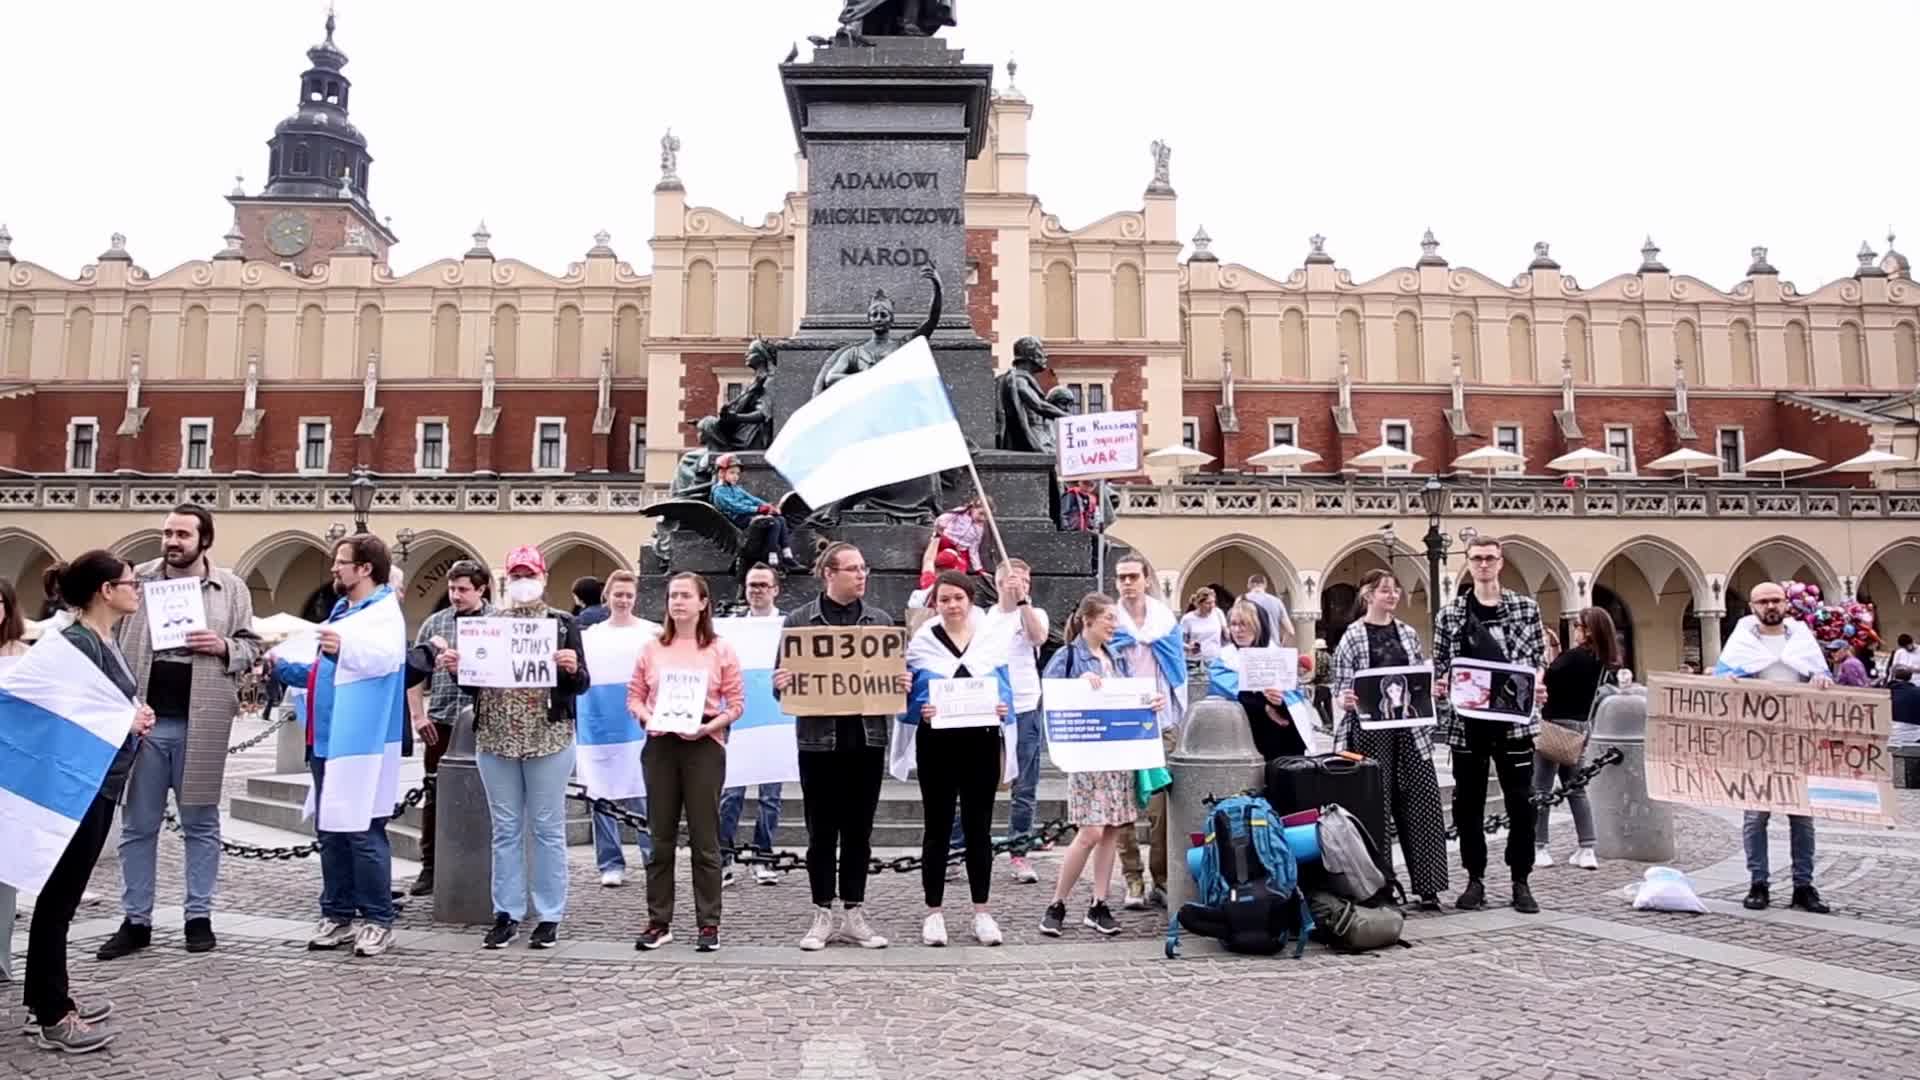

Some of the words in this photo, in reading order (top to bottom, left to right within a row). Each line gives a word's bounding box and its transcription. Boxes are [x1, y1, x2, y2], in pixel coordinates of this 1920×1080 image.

[831, 172, 938, 190] ADAMOWI
[812, 207, 961, 225] MICKIEWICZOWI
[840, 240, 929, 266] NARÓD
[1081, 450, 1117, 464] WAR
[512, 623, 538, 634] STOP
[785, 631, 905, 658] ПОЗОР!
[512, 660, 550, 682] WAR
[1664, 687, 1728, 717] THAT'S
[1742, 692, 1792, 723] NOT
[1808, 700, 1878, 730] WHAT
[1669, 723, 1730, 756] THEY
[1747, 729, 1816, 767] DIED
[1828, 740, 1885, 771] FOR
[1670, 763, 1703, 793] IN
